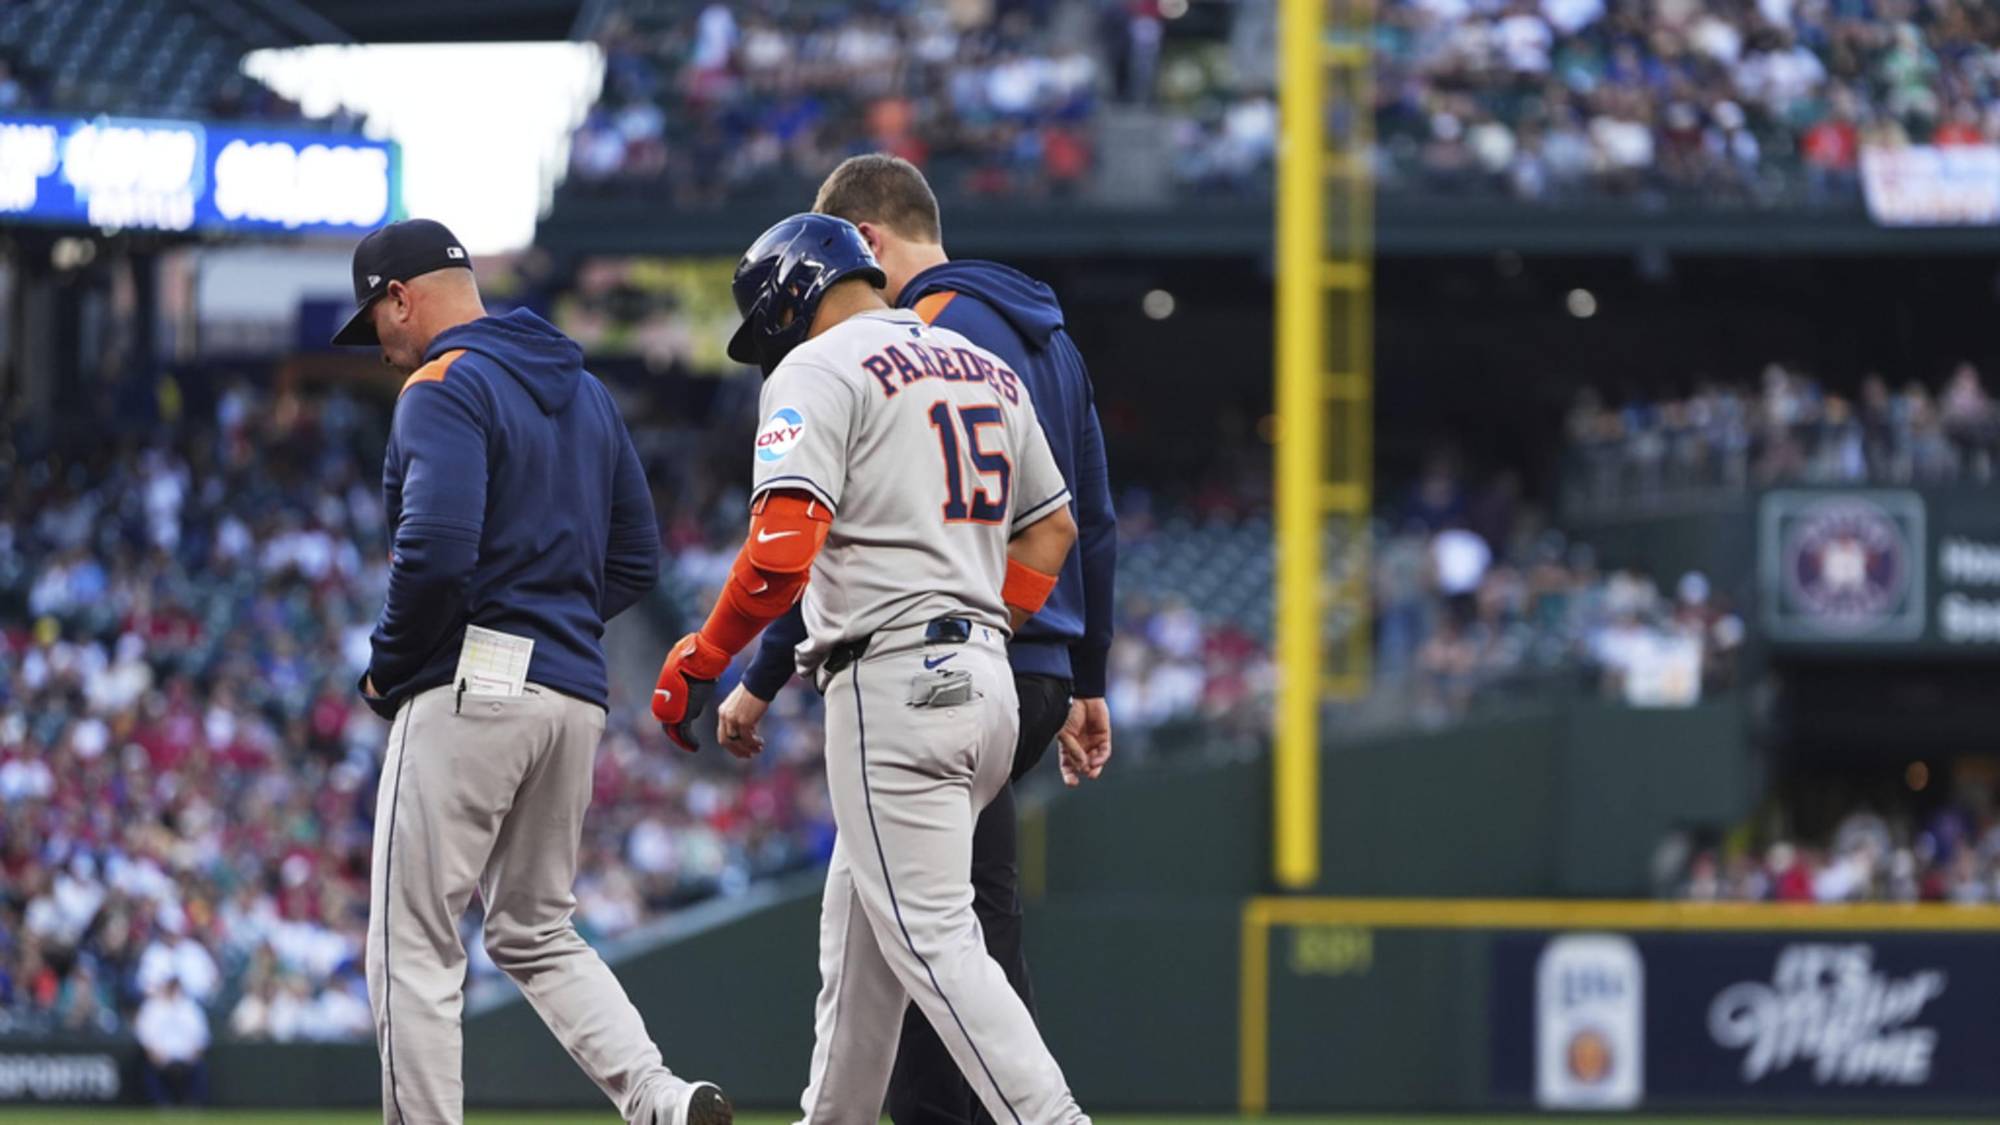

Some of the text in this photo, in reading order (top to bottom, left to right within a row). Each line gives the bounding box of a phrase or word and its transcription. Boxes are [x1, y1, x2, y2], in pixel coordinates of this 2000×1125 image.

[862, 342, 1020, 406] PAREDES
[757, 426, 803, 447] OXY
[928, 400, 1011, 525] 15
